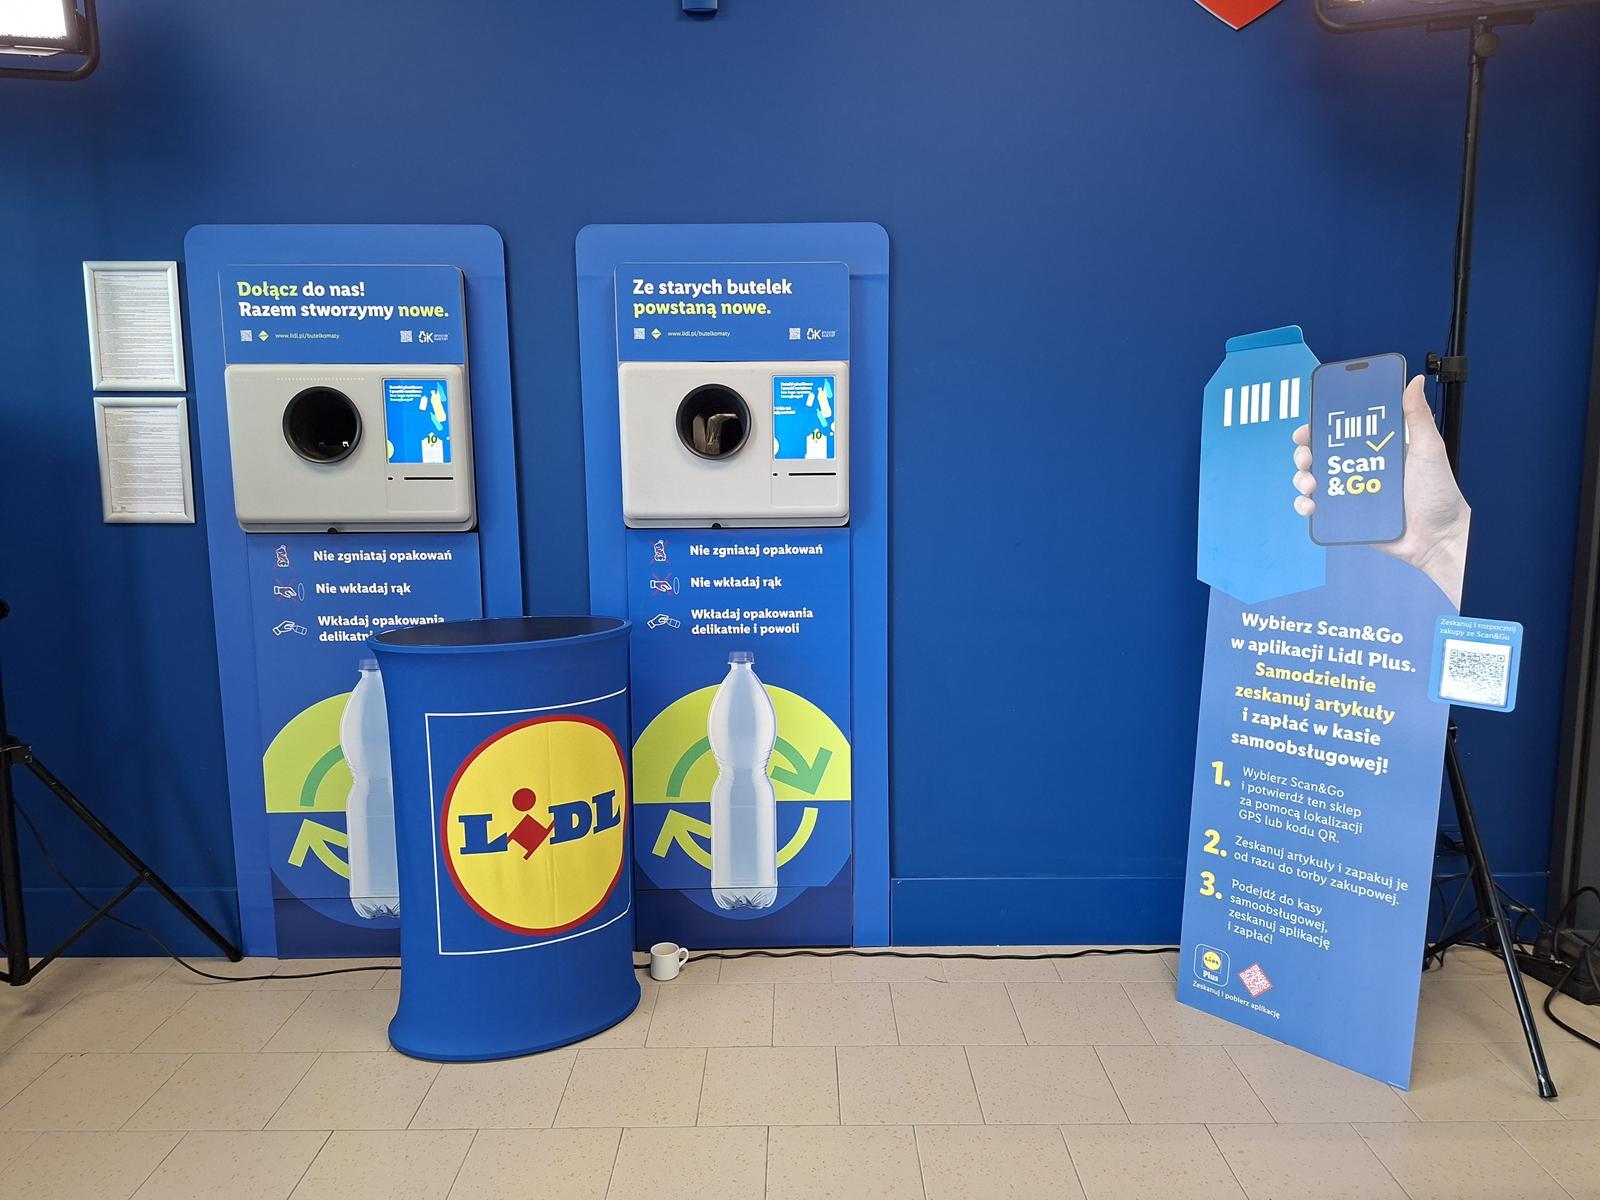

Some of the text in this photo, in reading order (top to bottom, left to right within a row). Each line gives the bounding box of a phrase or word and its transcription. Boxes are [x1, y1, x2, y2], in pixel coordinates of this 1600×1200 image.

[237, 281, 365, 300] Dołącz do nas!
[633, 279, 792, 299] Ze starych butelek
[239, 302, 449, 321] Razem stworzymy nowe.
[633, 301, 772, 318] powstaną nowe.
[1328, 456, 1385, 475] Scan
[1328, 475, 1381, 497] &Go
[314, 550, 452, 563] Nie zgniataj opakowań
[690, 544, 823, 558] Nie zgniataj opakowań
[316, 583, 411, 596] Nie wkładaj rąk
[691, 576, 782, 589] Nie wkładaj rąk
[318, 615, 445, 628] Wkładaj opakowania
[691, 608, 813, 621] Wkładaj opakowania
[692, 623, 800, 636] delikatnie i powoli
[1242, 612, 1404, 644] Wybierz Scan&Go
[1440, 629, 1464, 637] zakupy
[1477, 631, 1510, 640] Scan&Go
[1441, 619, 1472, 628] Zeskanuj
[1478, 623, 1516, 634] rozpocznij
[1231, 639, 1416, 672] w aplikacji Lidl Plus.
[1255, 662, 1376, 693] Samodzielnie
[1235, 686, 1395, 724] zeskanuj artykuły
[1243, 707, 1381, 746] i zapłać w kasie
[1232, 733, 1388, 775] samoobsługowej!
[1211, 761, 1344, 797] 1. Wybierz Scan&Go
[1241, 782, 1361, 819] i potwierdź ten sklep
[1239, 810, 1340, 843] GPS lub kodu QR.
[1240, 797, 1363, 835] za pomocą lokalizacji
[1204, 829, 1408, 892] 2. Zeskanuj artykuły i zapakuj je
[1234, 851, 1400, 906] od razu do torby zakupowej.
[1200, 871, 1322, 916] 3. Podejdź do kasy
[1230, 896, 1328, 933] samoobsługowej,
[1228, 909, 1330, 949] zeskanuj aplikację
[1228, 922, 1273, 944] i zapłać!
[1203, 970, 1219, 982] Plus
[1193, 981, 1220, 997] Zeskanuj
[1225, 994, 1249, 1007] pobierz
[1251, 1003, 1280, 1019] aplikację
